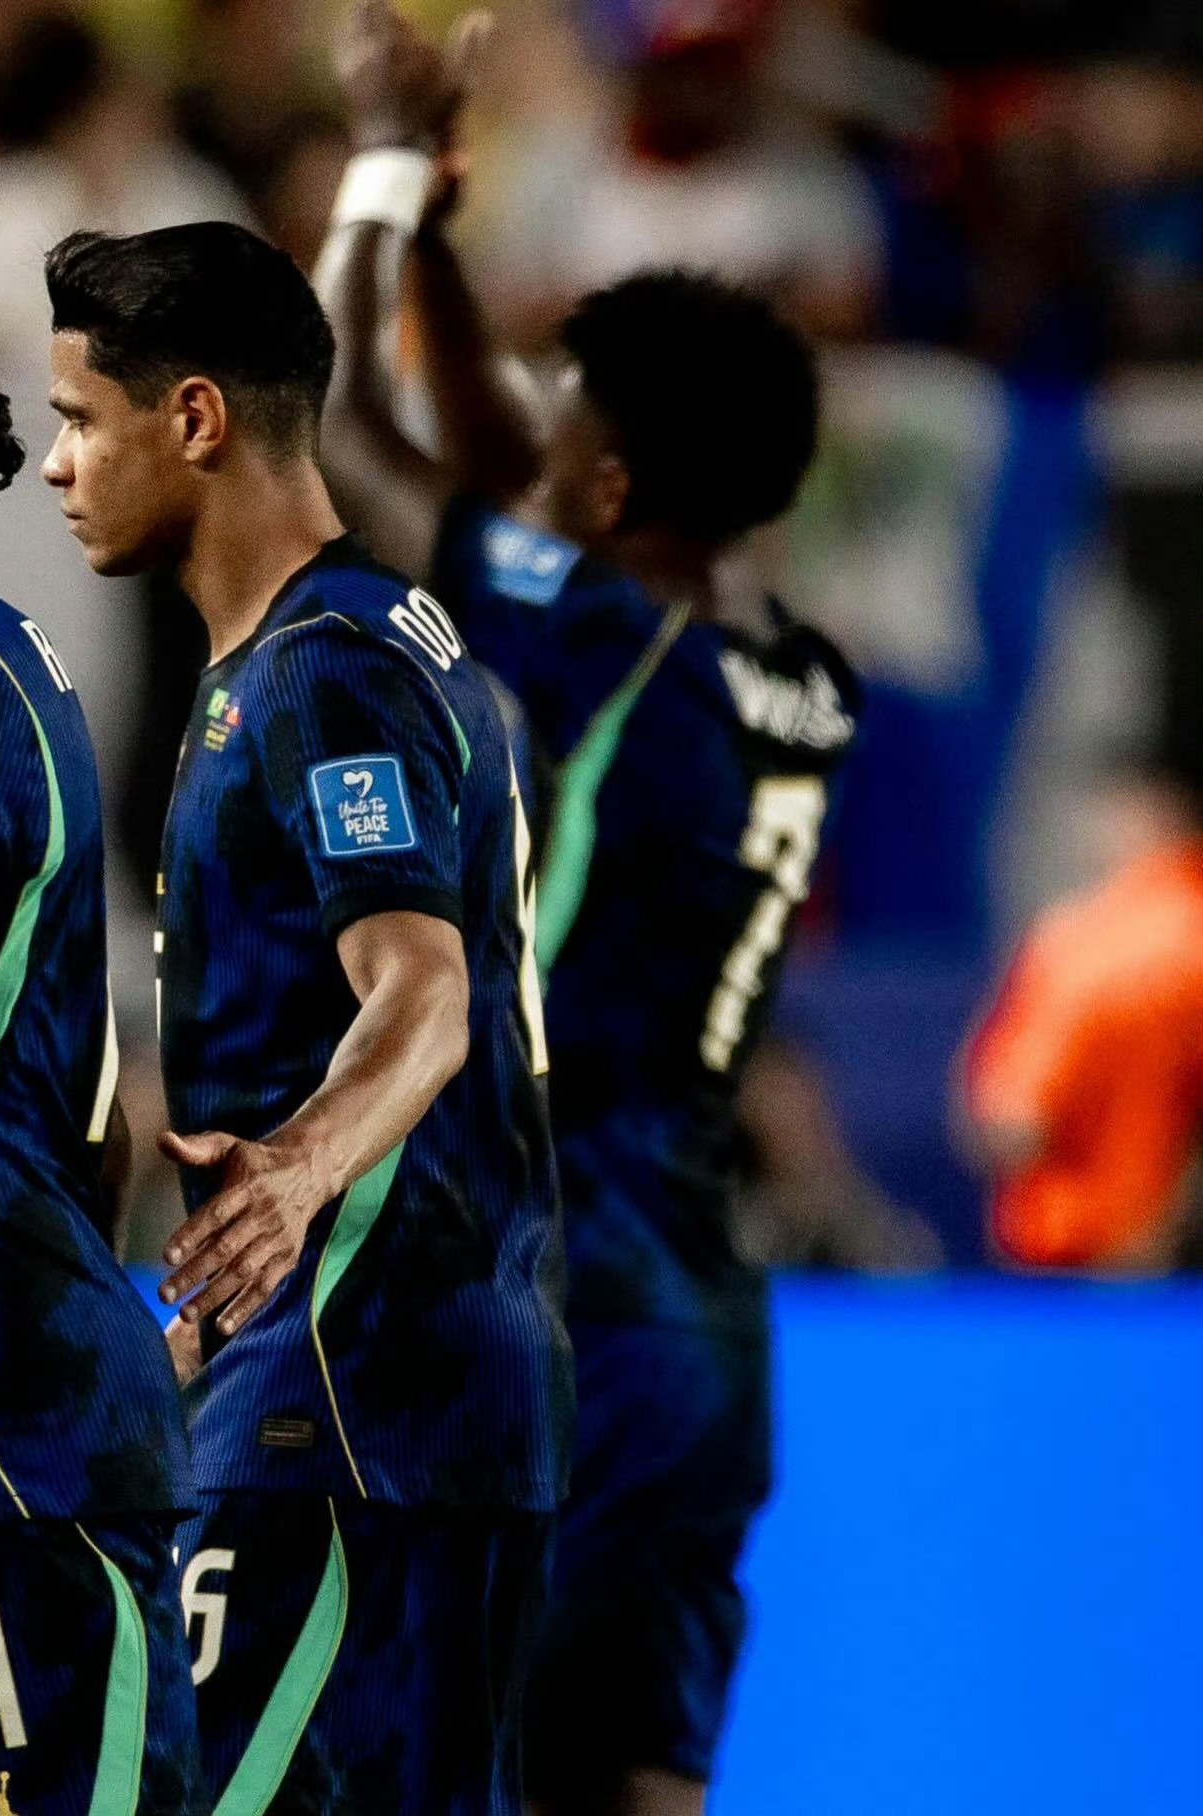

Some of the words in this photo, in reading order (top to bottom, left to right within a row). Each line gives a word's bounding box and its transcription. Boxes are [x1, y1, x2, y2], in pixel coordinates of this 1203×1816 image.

[338, 799, 370, 820] Unite
[369, 797, 388, 814] For
[345, 815, 390, 836] PEACE
[356, 833, 382, 845] FIFA
[172, 1547, 236, 1686] 6
